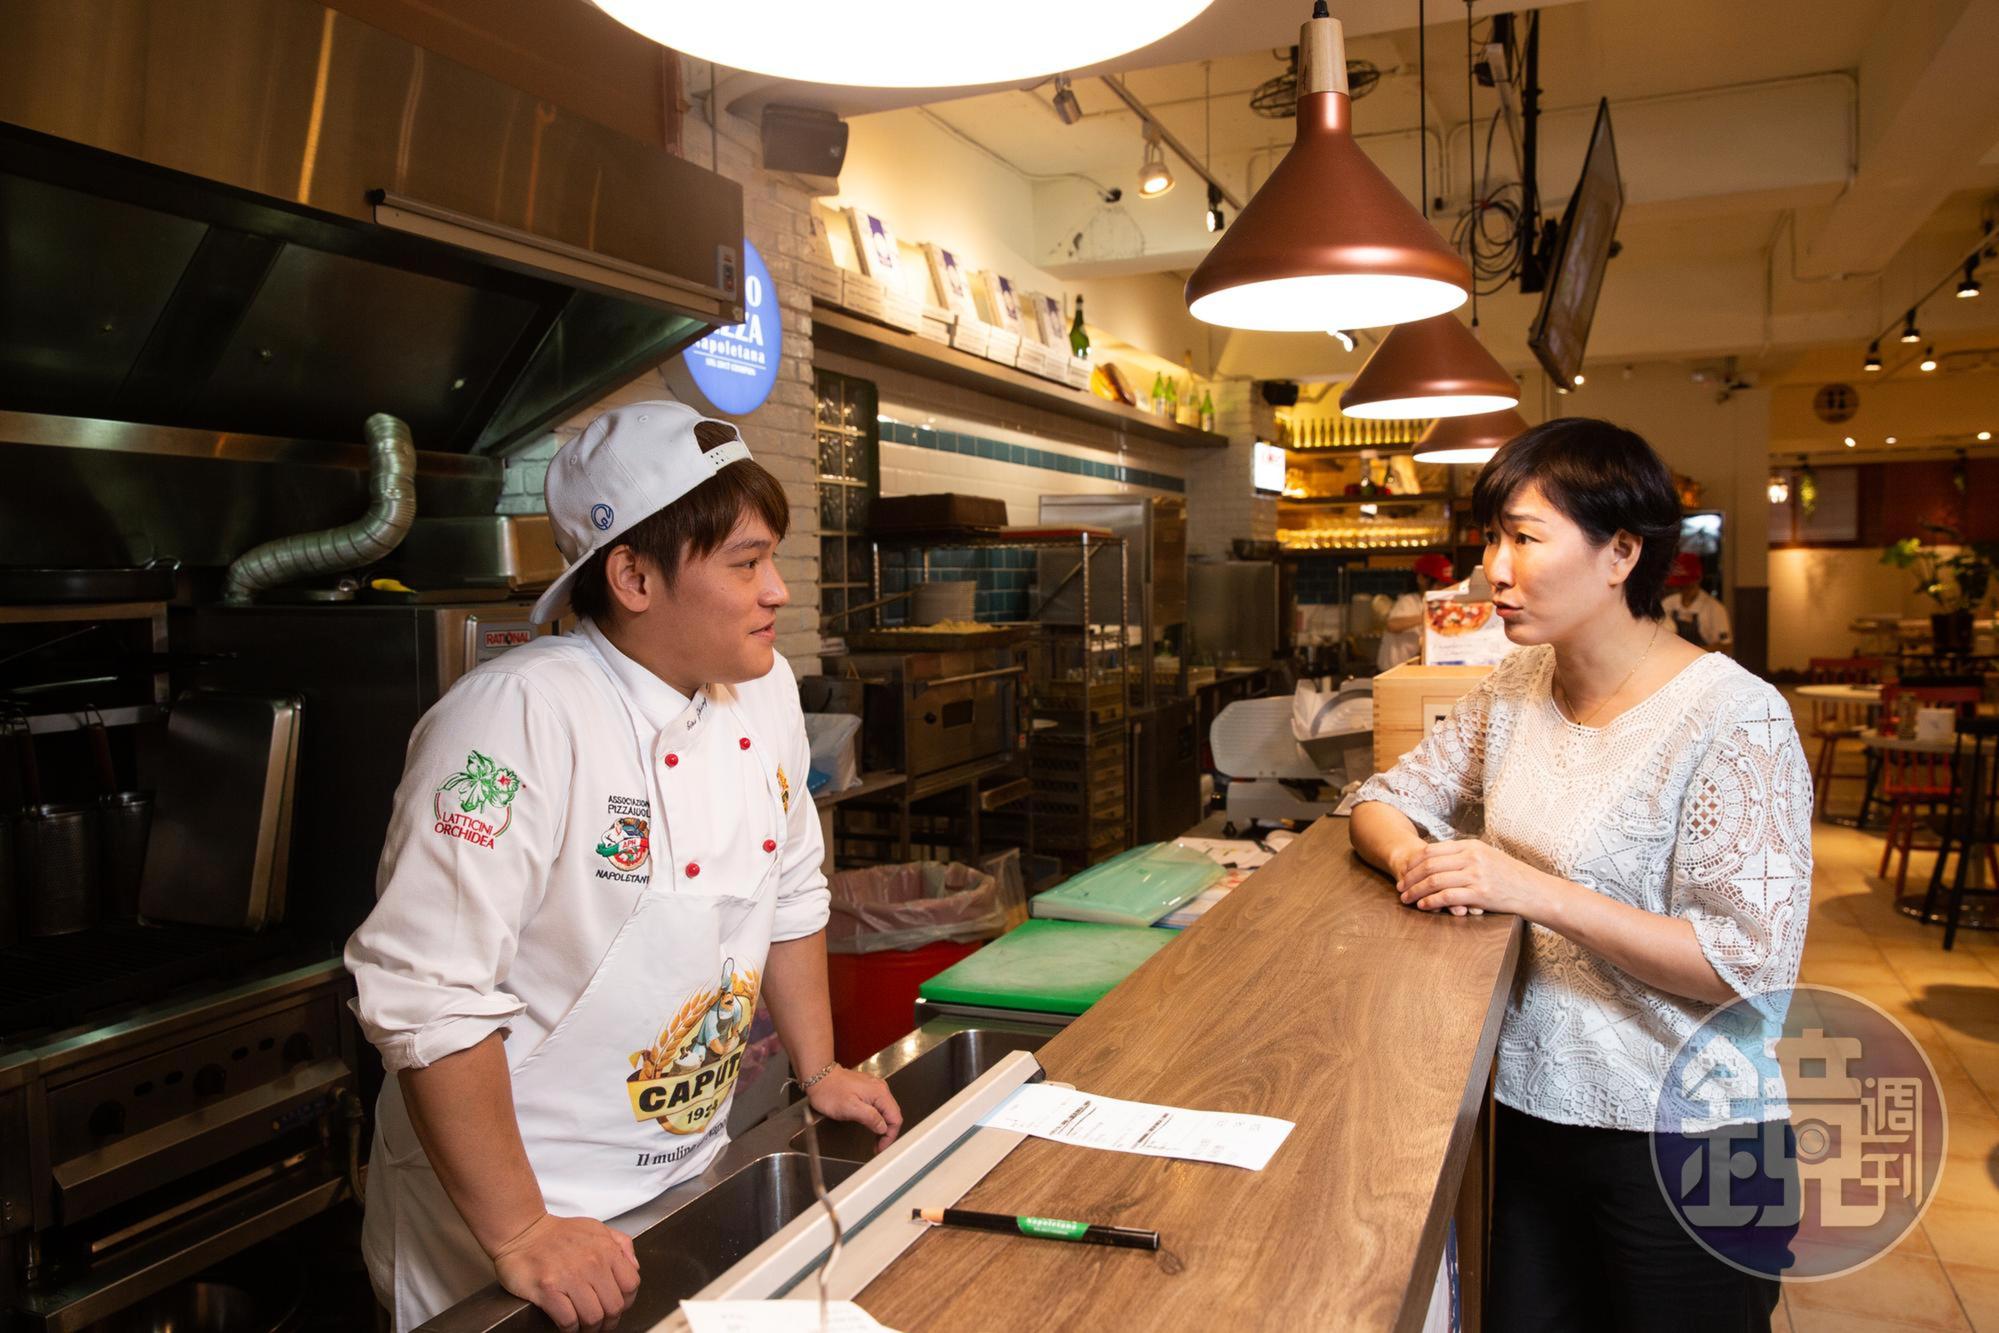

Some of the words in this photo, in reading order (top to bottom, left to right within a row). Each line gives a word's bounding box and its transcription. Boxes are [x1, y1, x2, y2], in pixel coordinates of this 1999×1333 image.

[442, 811, 493, 835] LATTICINI
[607, 804, 651, 818] PIZZAIUOL
[434, 822, 495, 850] ORCHIDEA
[638, 1051, 741, 1113] CAPUT
